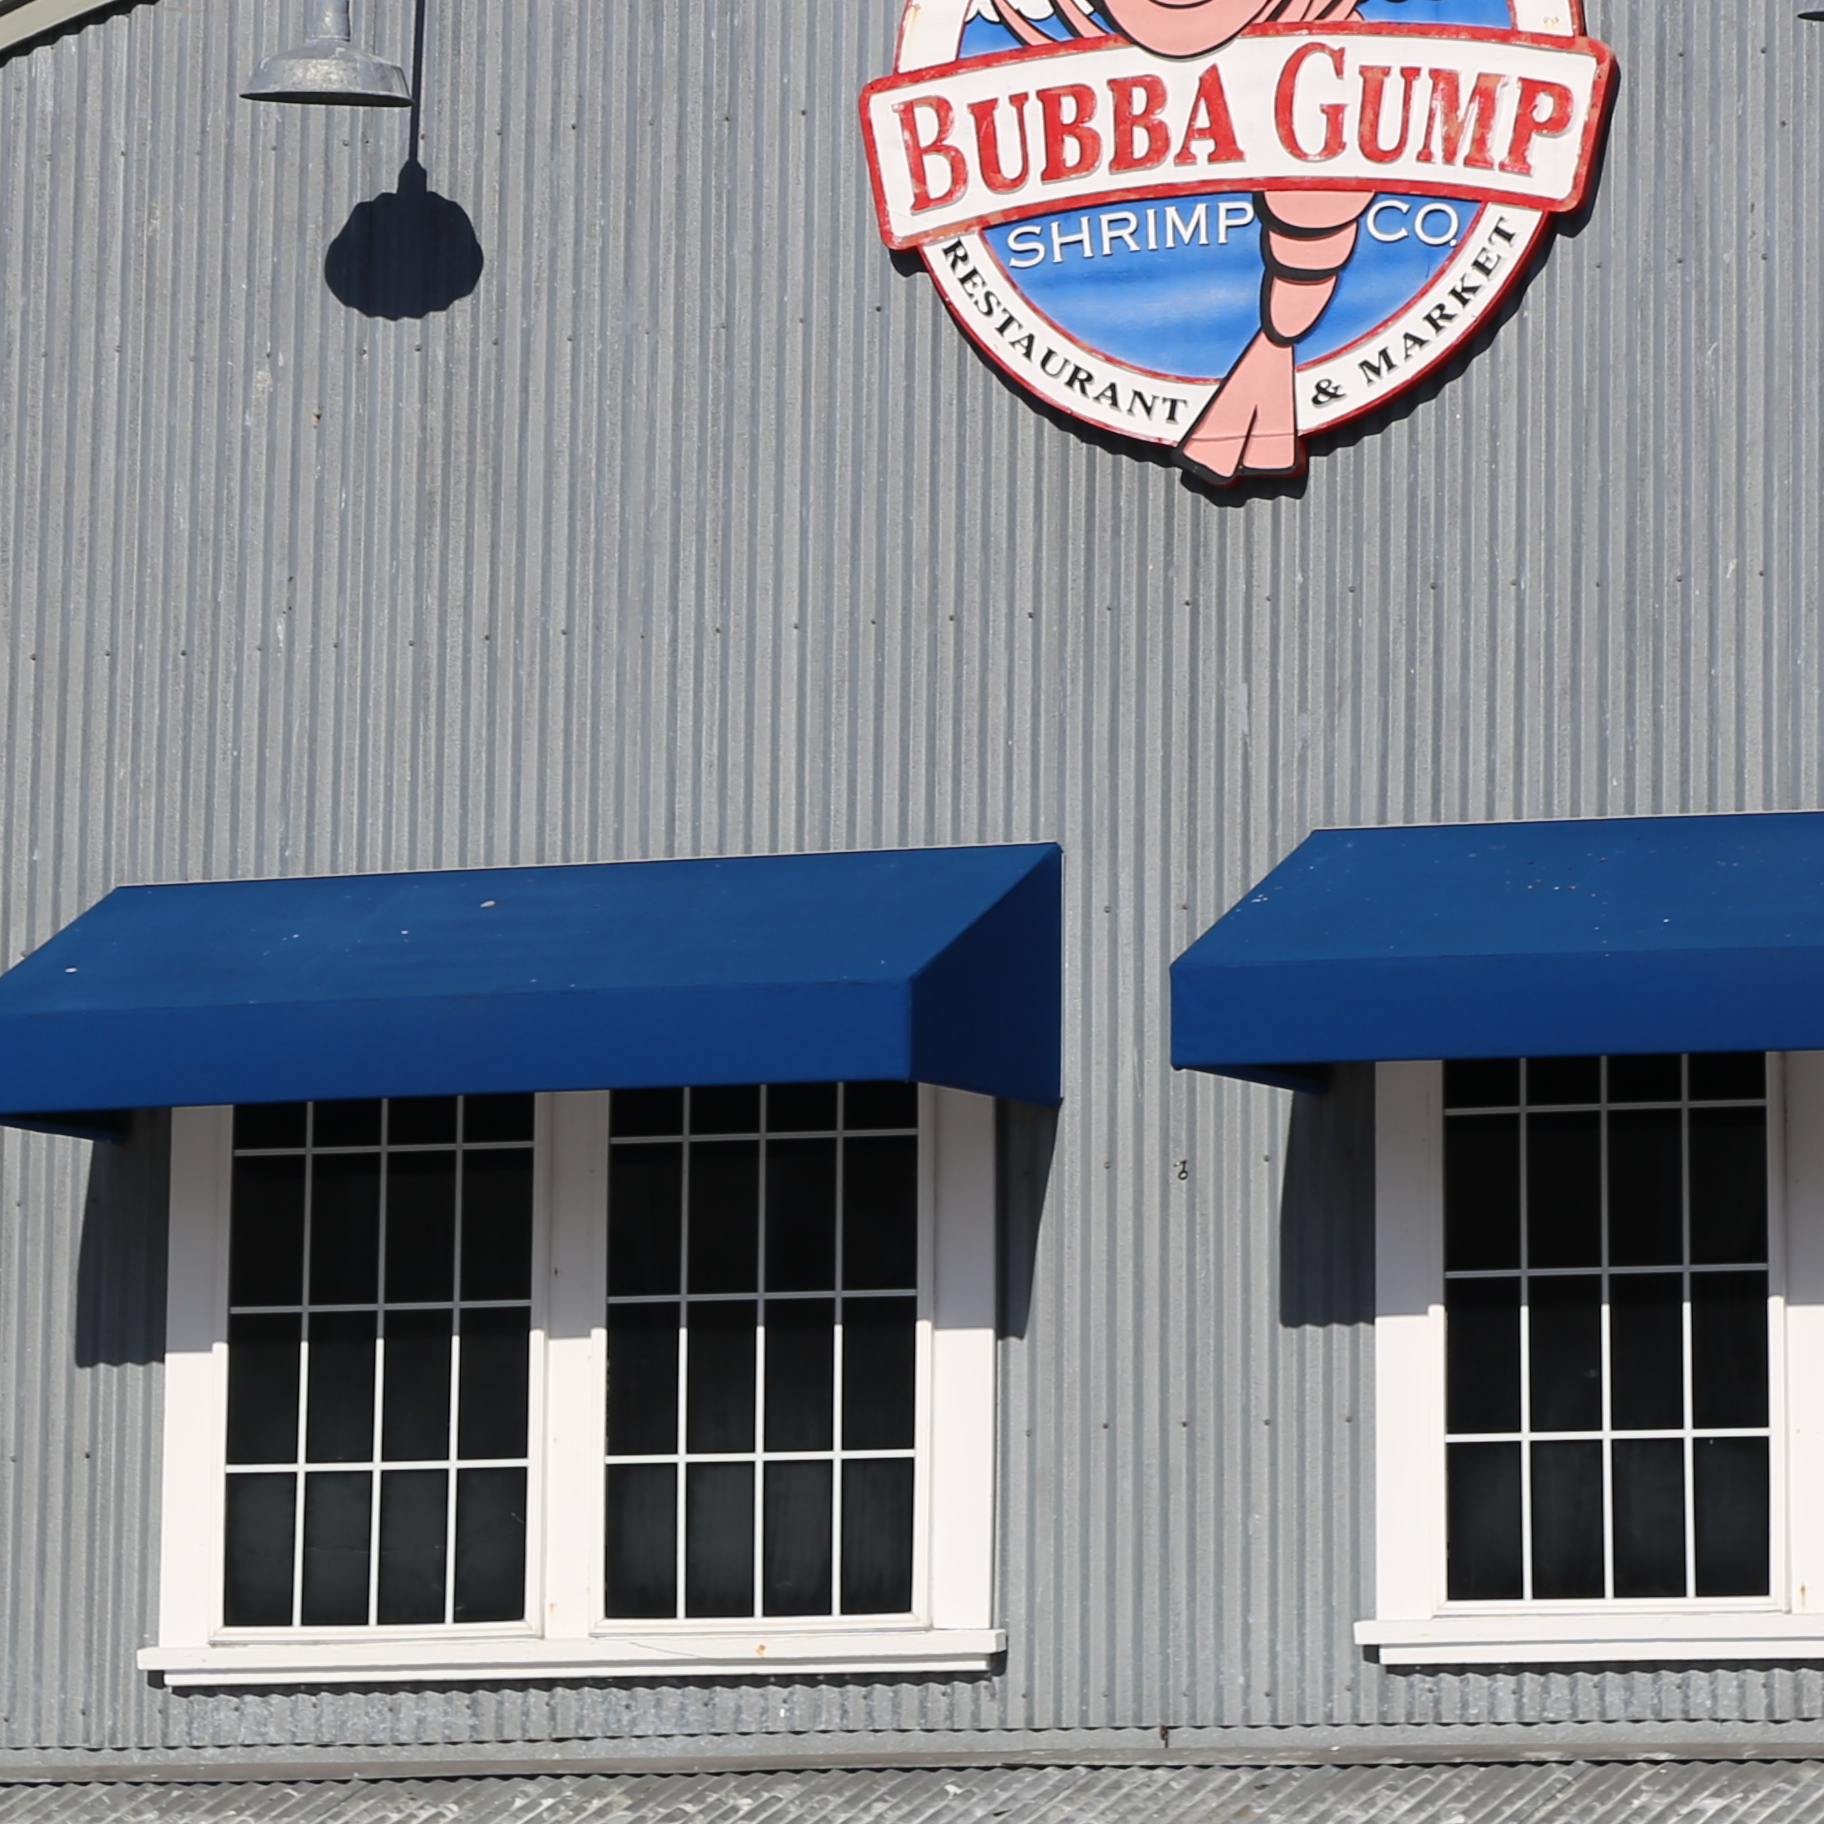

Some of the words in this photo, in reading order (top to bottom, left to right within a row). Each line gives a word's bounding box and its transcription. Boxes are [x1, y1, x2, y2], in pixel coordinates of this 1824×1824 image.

[891, 62, 1247, 213] BUBBA
[1274, 42, 1574, 177] GUMP
[1006, 201, 1255, 268] SHRIMP
[1366, 198, 1460, 248] CO.
[941, 236, 1188, 423] RESTAURANT
[1310, 378, 1346, 407] &
[1356, 216, 1517, 386] MARKET
